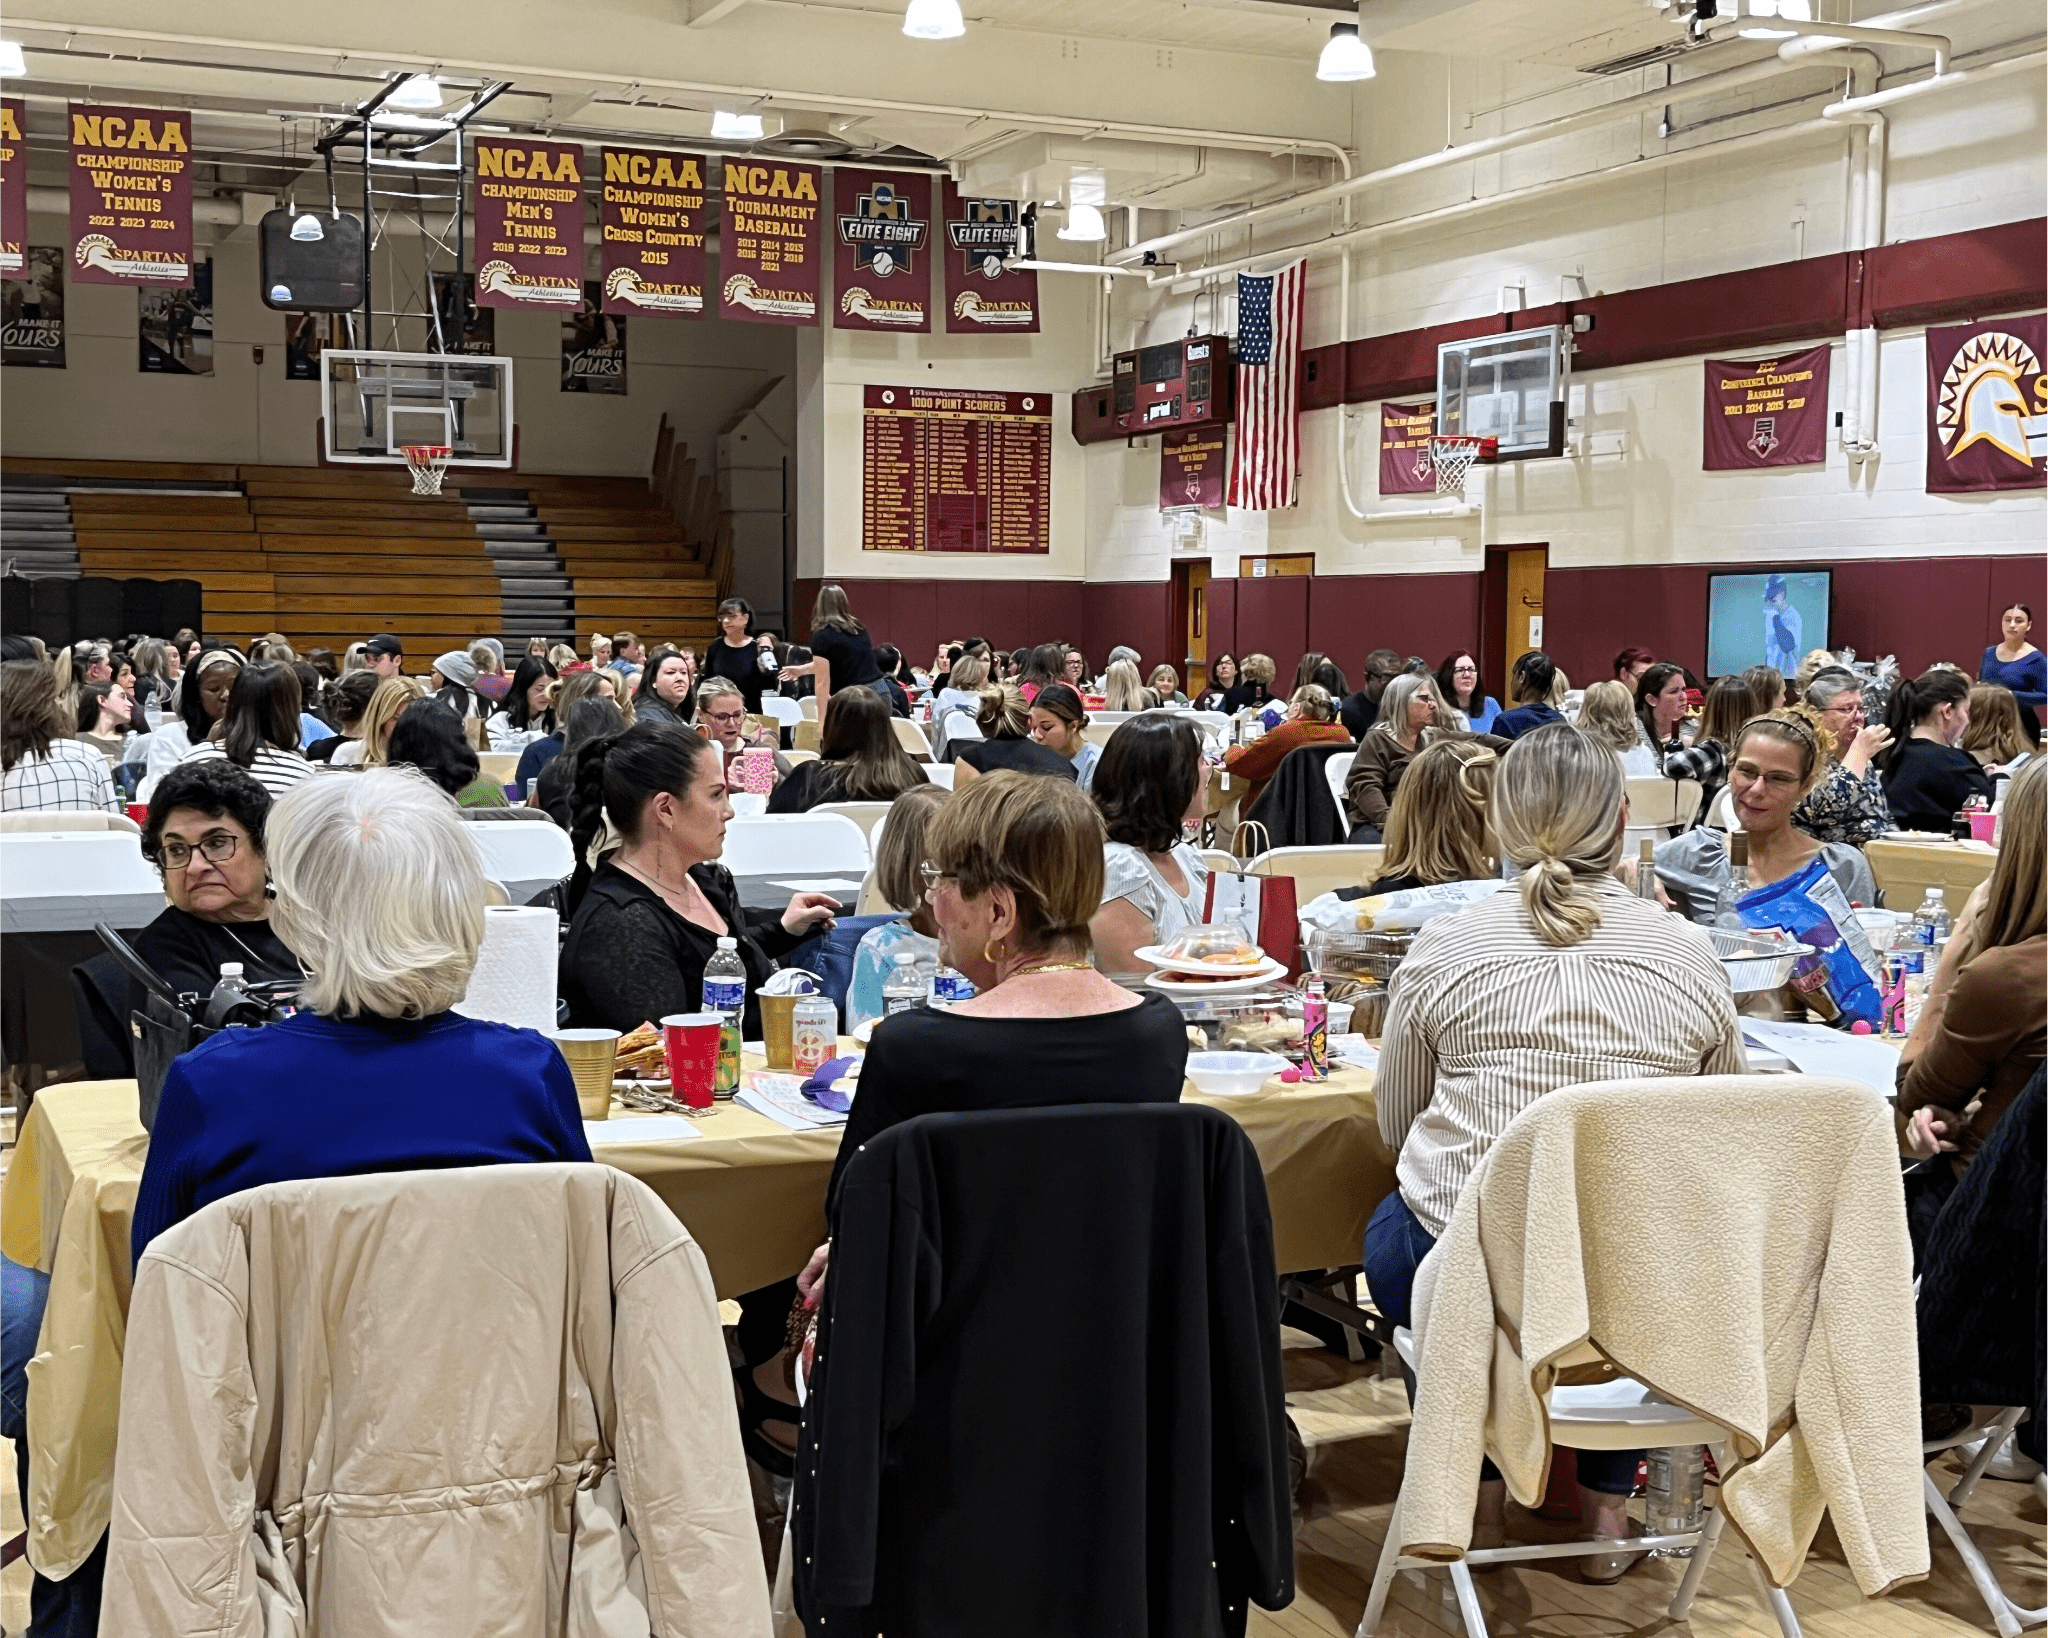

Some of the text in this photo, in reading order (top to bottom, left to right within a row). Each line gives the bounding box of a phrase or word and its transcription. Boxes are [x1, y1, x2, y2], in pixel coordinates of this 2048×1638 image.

[73, 114, 188, 152] NCAA
[77, 154, 184, 174] CHAMPIONSHIP
[478, 146, 580, 182] NCAA
[604, 152, 702, 189] NCAA
[90, 171, 171, 192] WOMEN'S
[725, 164, 817, 200] NCAA
[482, 184, 578, 202] CHAMPIONSHIP
[604, 186, 703, 209] CHAMPIONSHIP
[102, 192, 162, 212] TENNIS
[726, 197, 816, 220] TOURNAMENT
[506, 202, 553, 220] MEN'S
[620, 207, 689, 227] WOMEN'S
[89, 215, 175, 229] 2022 2023 2024
[503, 220, 557, 239] TENNIS
[735, 214, 806, 237] BASEBALL
[604, 225, 703, 247] CROSS COUNTRY
[848, 223, 920, 242] ELITE EIGHT
[958, 228, 1017, 243] ELITE EIGH
[519, 244, 541, 254] 2022
[761, 240, 780, 250] 2014
[784, 242, 804, 252] 2015
[113, 249, 186, 263] SPARTAN
[641, 251, 668, 265] 2015
[761, 251, 780, 261] 2017
[761, 261, 780, 272] 2021
[514, 275, 578, 288] SPARTAN
[639, 282, 701, 296] SPARTAN
[755, 288, 813, 302] SPARTAN
[869, 299, 922, 312] SPARTAN
[979, 302, 1031, 311] SPARTAN
[18, 318, 61, 328] MAKE IT
[587, 348, 613, 357] MAKE
[565, 350, 622, 378] YOURS
[1747, 388, 1784, 400] BASEBALL
[911, 397, 1006, 412] 1000 POINT SCORERS
